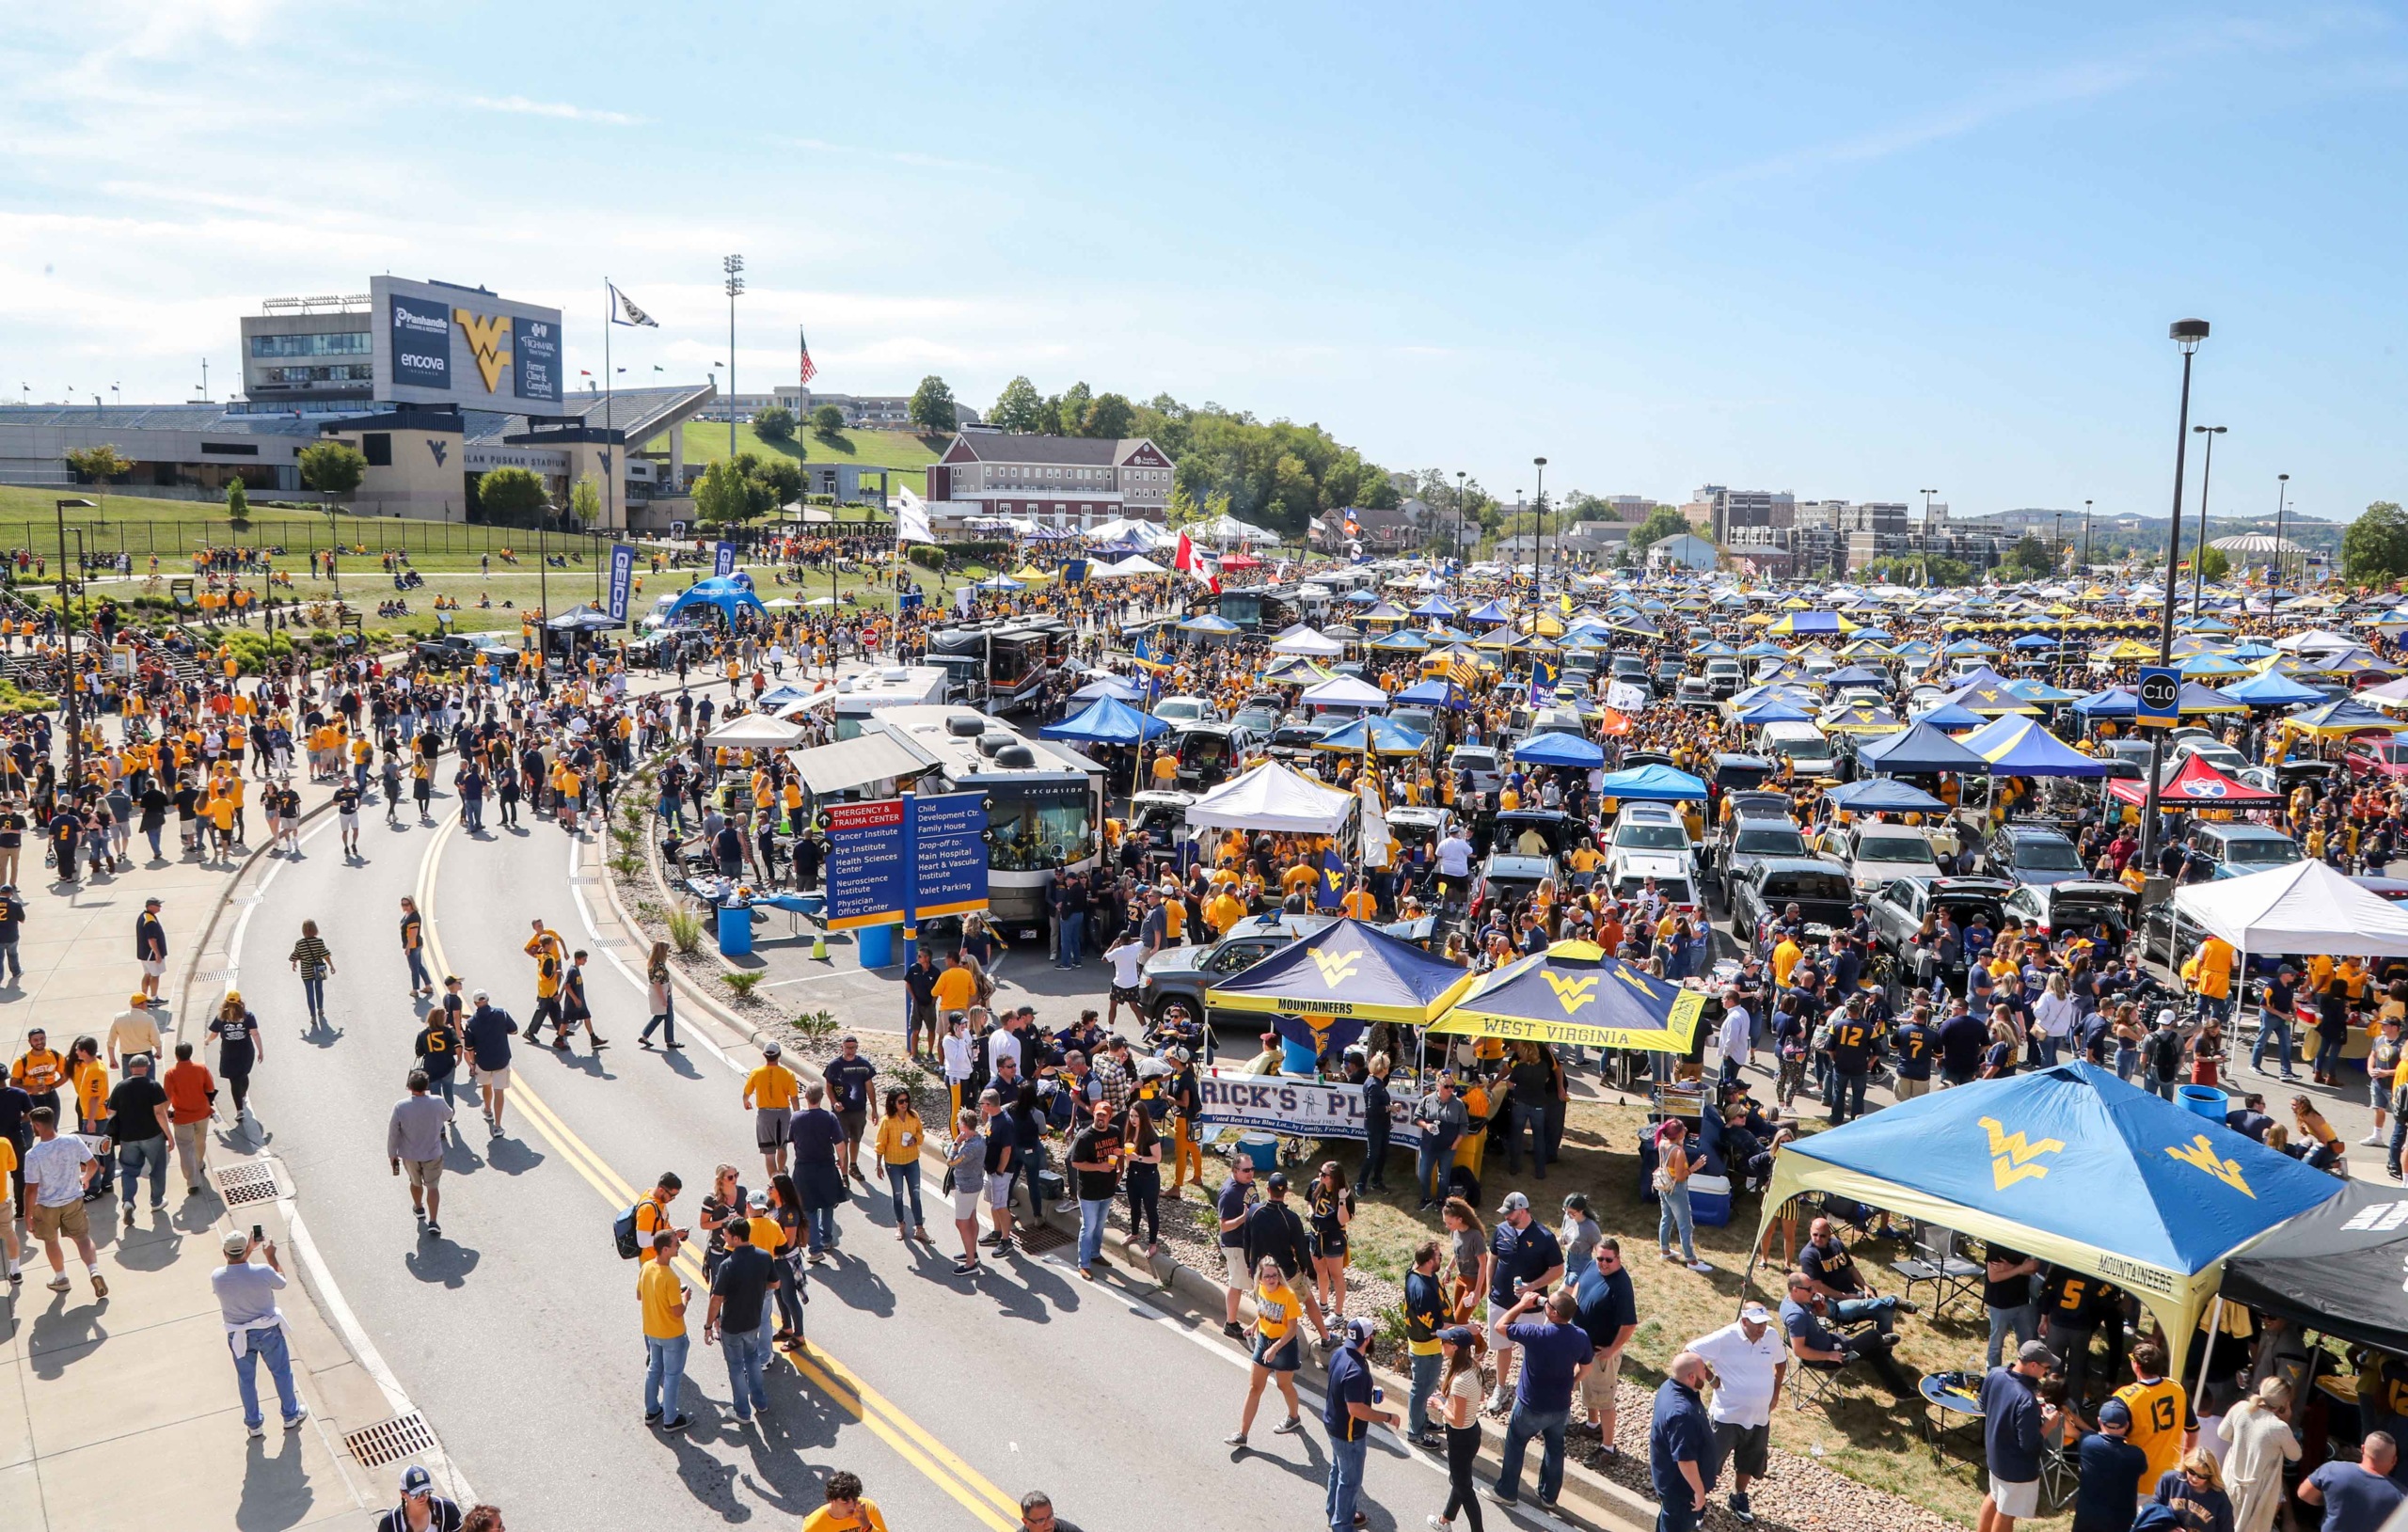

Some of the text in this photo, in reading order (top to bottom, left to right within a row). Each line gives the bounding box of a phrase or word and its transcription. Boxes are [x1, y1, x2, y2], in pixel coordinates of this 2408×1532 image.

[406, 313, 448, 329] Panhandle
[401, 354, 444, 371] encova
[527, 361, 546, 371] Farmer
[527, 371, 547, 382] Cline &
[527, 380, 552, 393] Campbell
[464, 455, 566, 467] ILAN PUSKAR STADIUM
[613, 552, 628, 618] GEICO
[2142, 685, 2176, 701] C10
[833, 807, 882, 818] EMERGENCY
[918, 804, 936, 813] Child
[833, 813, 899, 827] TRAUMA CENTER
[918, 811, 965, 822] Development
[60, 825, 69, 841] 2
[918, 822, 966, 834] Family House
[834, 829, 898, 842] Cancer Institute
[835, 843, 886, 855] Eye Institute
[918, 839, 950, 850] Drop-off
[836, 853, 897, 867] Health Sciences
[918, 848, 972, 861] Main Hospital
[836, 865, 863, 875] Center
[918, 862, 939, 872] Heart
[948, 858, 979, 868] Vascular
[836, 875, 889, 888] Neuroscience
[918, 870, 950, 881] Institute
[837, 886, 870, 896] Institute
[919, 882, 972, 895] Valet Parking
[837, 896, 874, 908] Physician
[837, 903, 889, 916] Office Center
[1278, 998, 1353, 1015] MOUNTAINEERS
[1483, 1019, 1629, 1045] WEST VIRGINIA
[1840, 1025, 1863, 1047] 12
[427, 1032, 446, 1052] 15
[1910, 1040, 1924, 1058] 7
[1201, 1081, 1414, 1126] RICK'S PLC
[1300, 1124, 1323, 1132] Family,
[1389, 1133, 1408, 1142] riends,
[1409, 1136, 1418, 1145] etc.
[2098, 1254, 2173, 1293] MOUNTAINEERS
[2060, 1279, 2085, 1310] 5
[2151, 1396, 2176, 1433] 13
